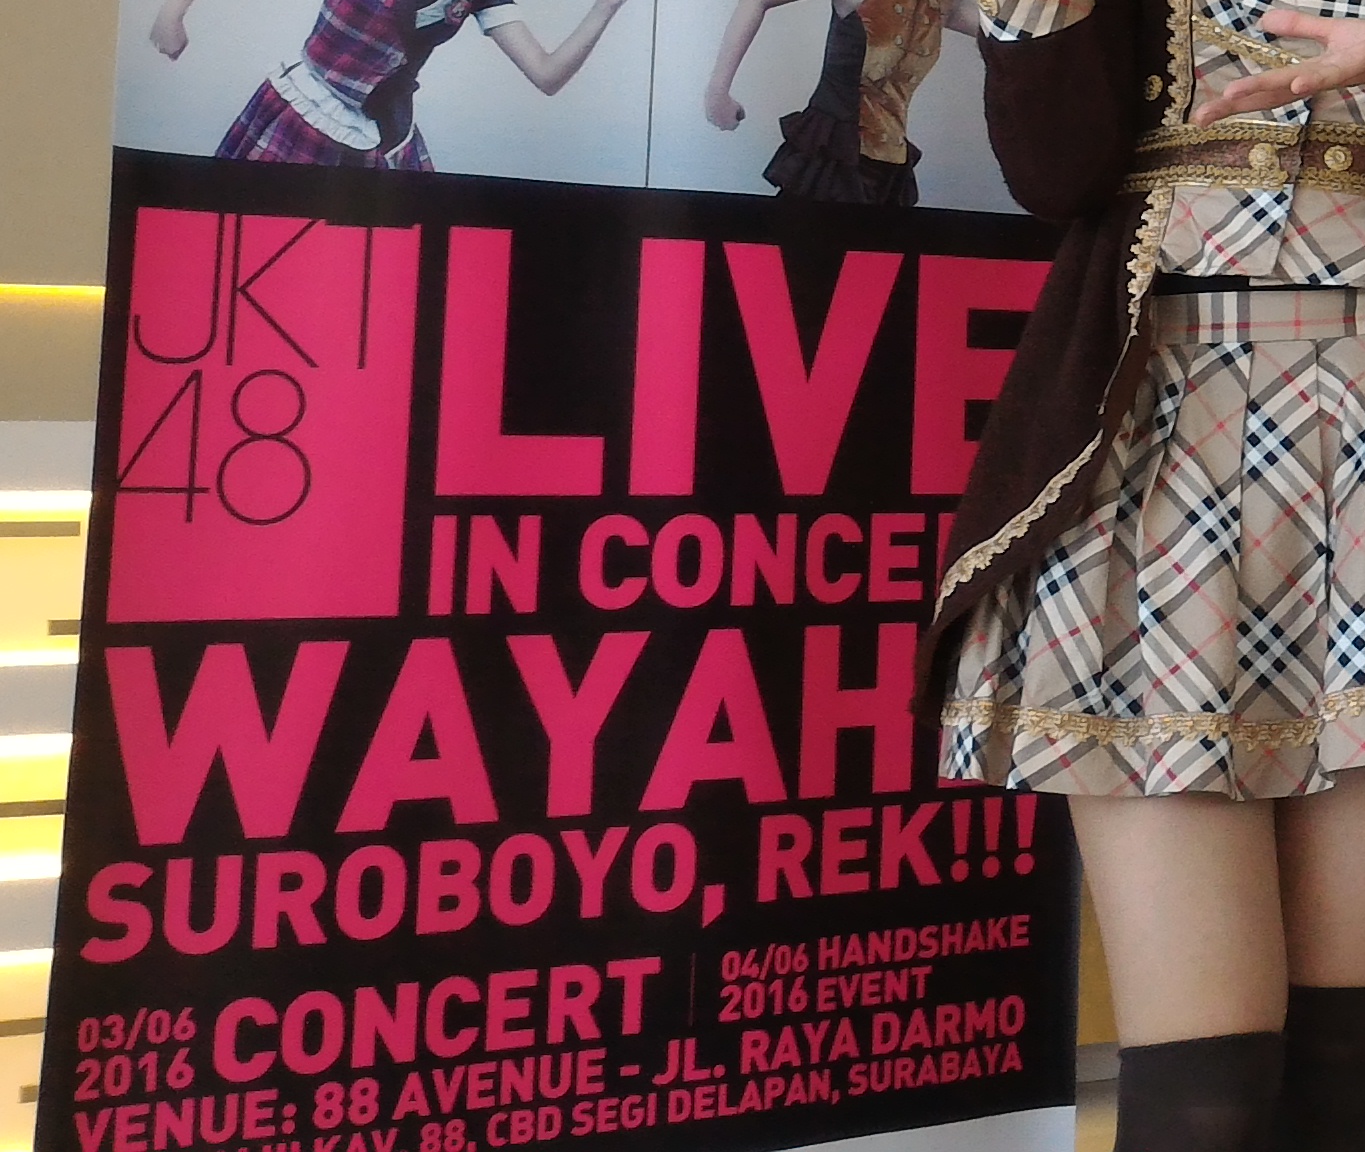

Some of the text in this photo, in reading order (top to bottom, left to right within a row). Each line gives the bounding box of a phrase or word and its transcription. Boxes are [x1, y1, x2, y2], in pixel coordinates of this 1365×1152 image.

[133, 211, 414, 369] JKT
[433, 225, 1054, 497] LIVE
[115, 369, 312, 525] 48
[427, 514, 543, 617] IN
[104, 623, 980, 846] WAYAH
[80, 794, 1038, 964] SUROBOYO, REK!!!
[718, 966, 932, 1023] 2016 EVENT
[721, 914, 1030, 983] 04/06 HANDSHAKE
[74, 1089, 298, 1152] VENUE:
[312, 1077, 380, 1130] 88
[392, 1048, 607, 1121] AVENUE
[652, 1038, 726, 1086] JL.
[740, 1018, 860, 1075] RAYA
[872, 995, 1025, 1055] DARMO
[74, 1048, 195, 1102] 2016
[78, 1007, 197, 1054] 03/06
[212, 957, 662, 1083] CONCERT
[486, 1105, 563, 1147] CBD
[571, 1093, 658, 1137] SEGI
[667, 1070, 839, 1123] DELAPAN,
[848, 1043, 1023, 1096] SURABAYA
